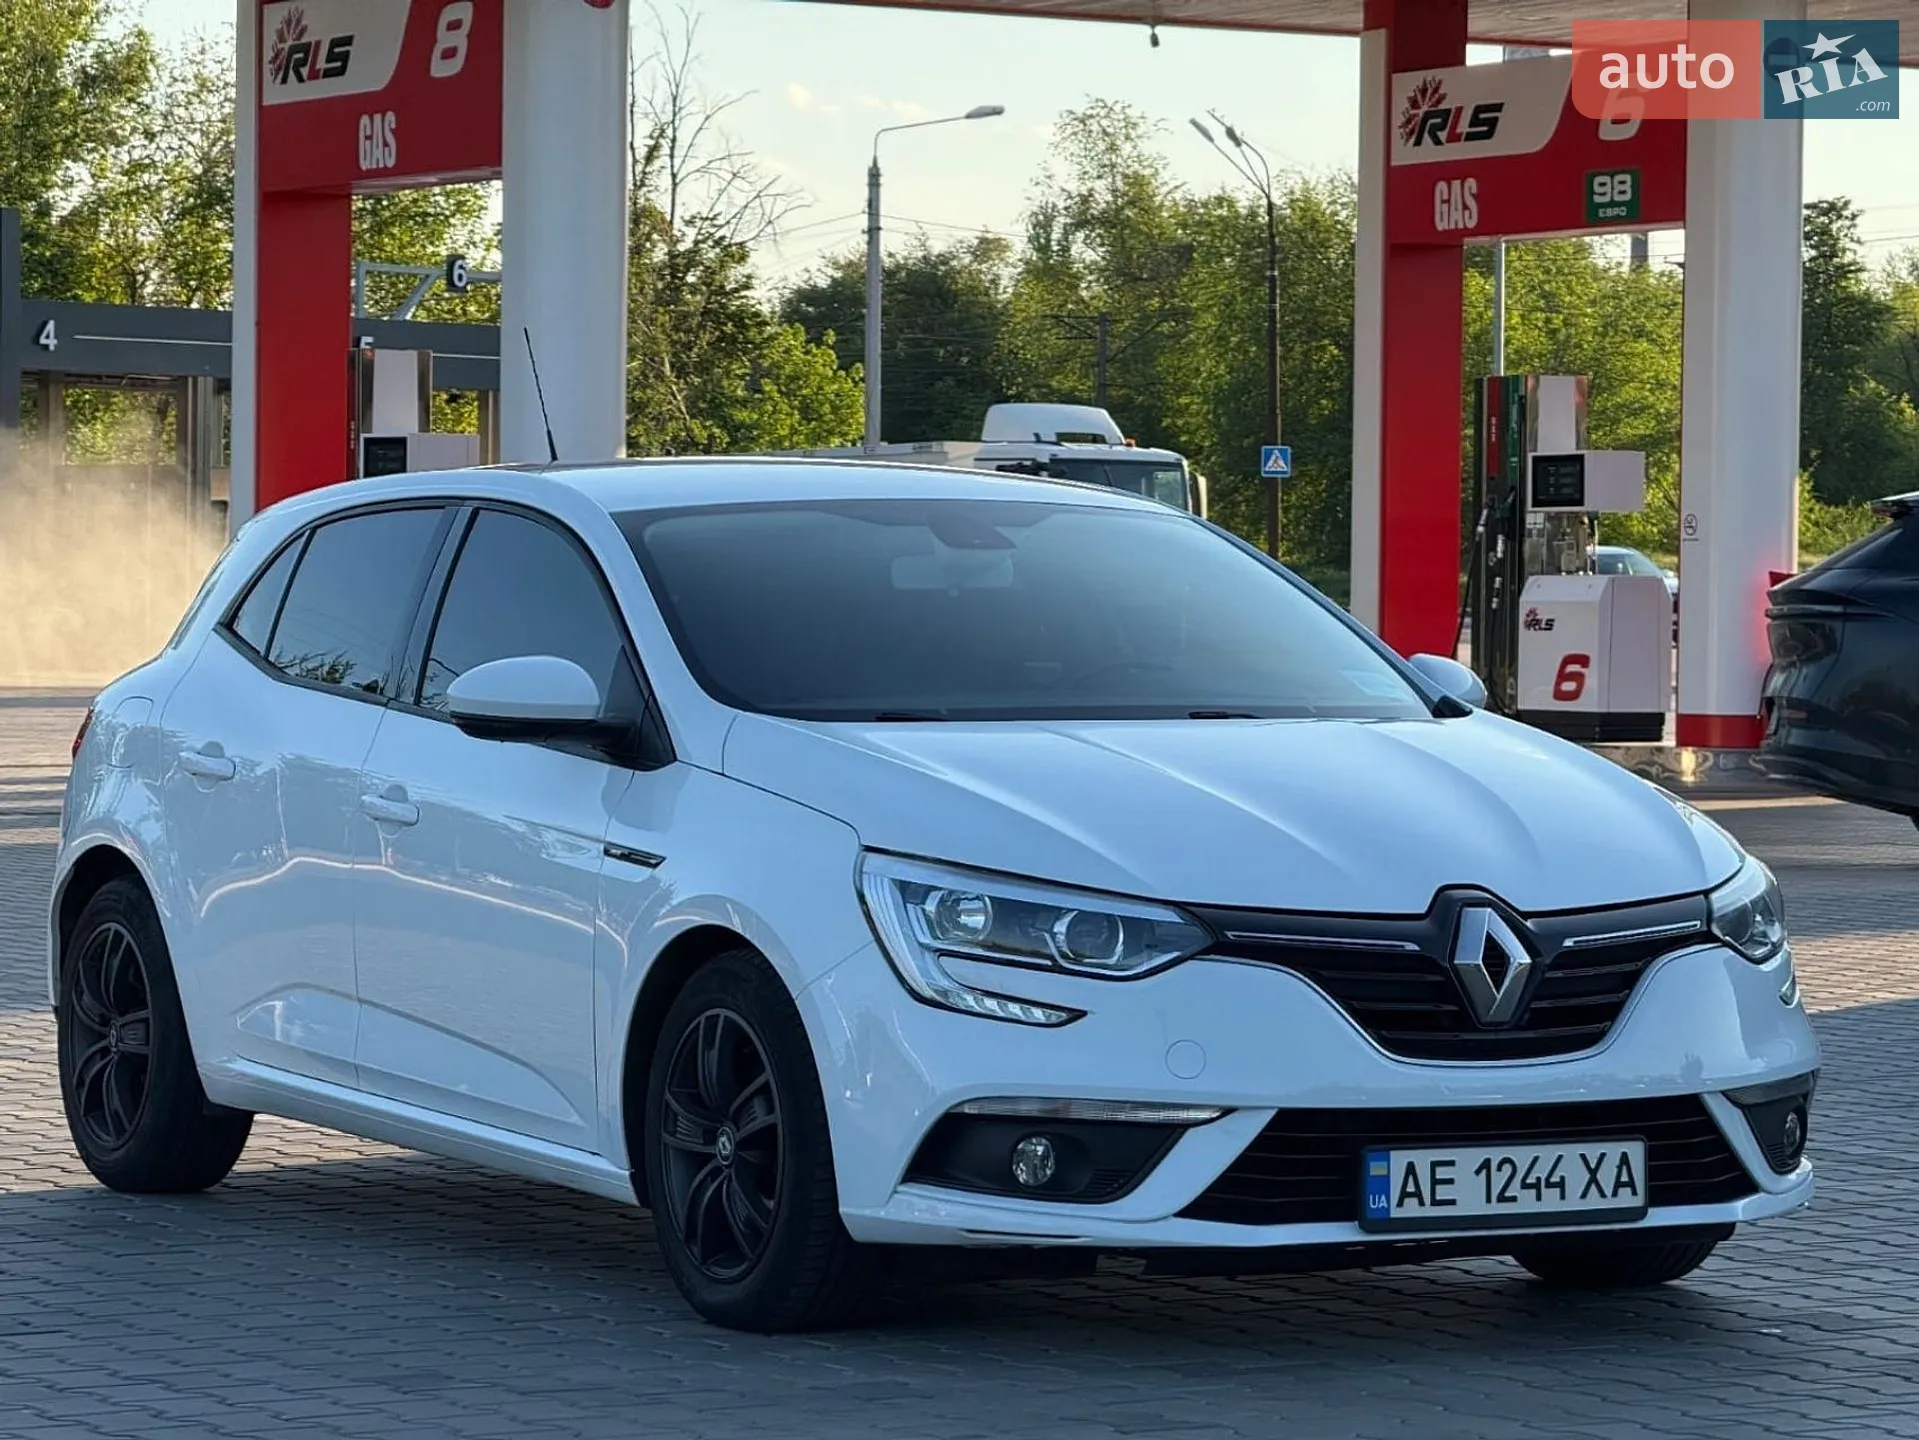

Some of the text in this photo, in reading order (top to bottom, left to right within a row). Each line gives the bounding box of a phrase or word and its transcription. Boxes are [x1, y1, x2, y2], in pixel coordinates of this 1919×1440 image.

[280, 35, 355, 85] RLS
[430, 1, 474, 78] 8
[358, 111, 397, 171] GAS
[1413, 102, 1505, 147] RLS
[1434, 177, 1479, 231] GAS
[1593, 174, 1632, 203] 98
[452, 259, 469, 288] 6
[39, 319, 58, 351] 4
[1526, 618, 1556, 632] RLS
[1552, 653, 1591, 702] 6
[1369, 1194, 1389, 1209] UA
[1396, 1150, 1639, 1208] AE 1244 XA
